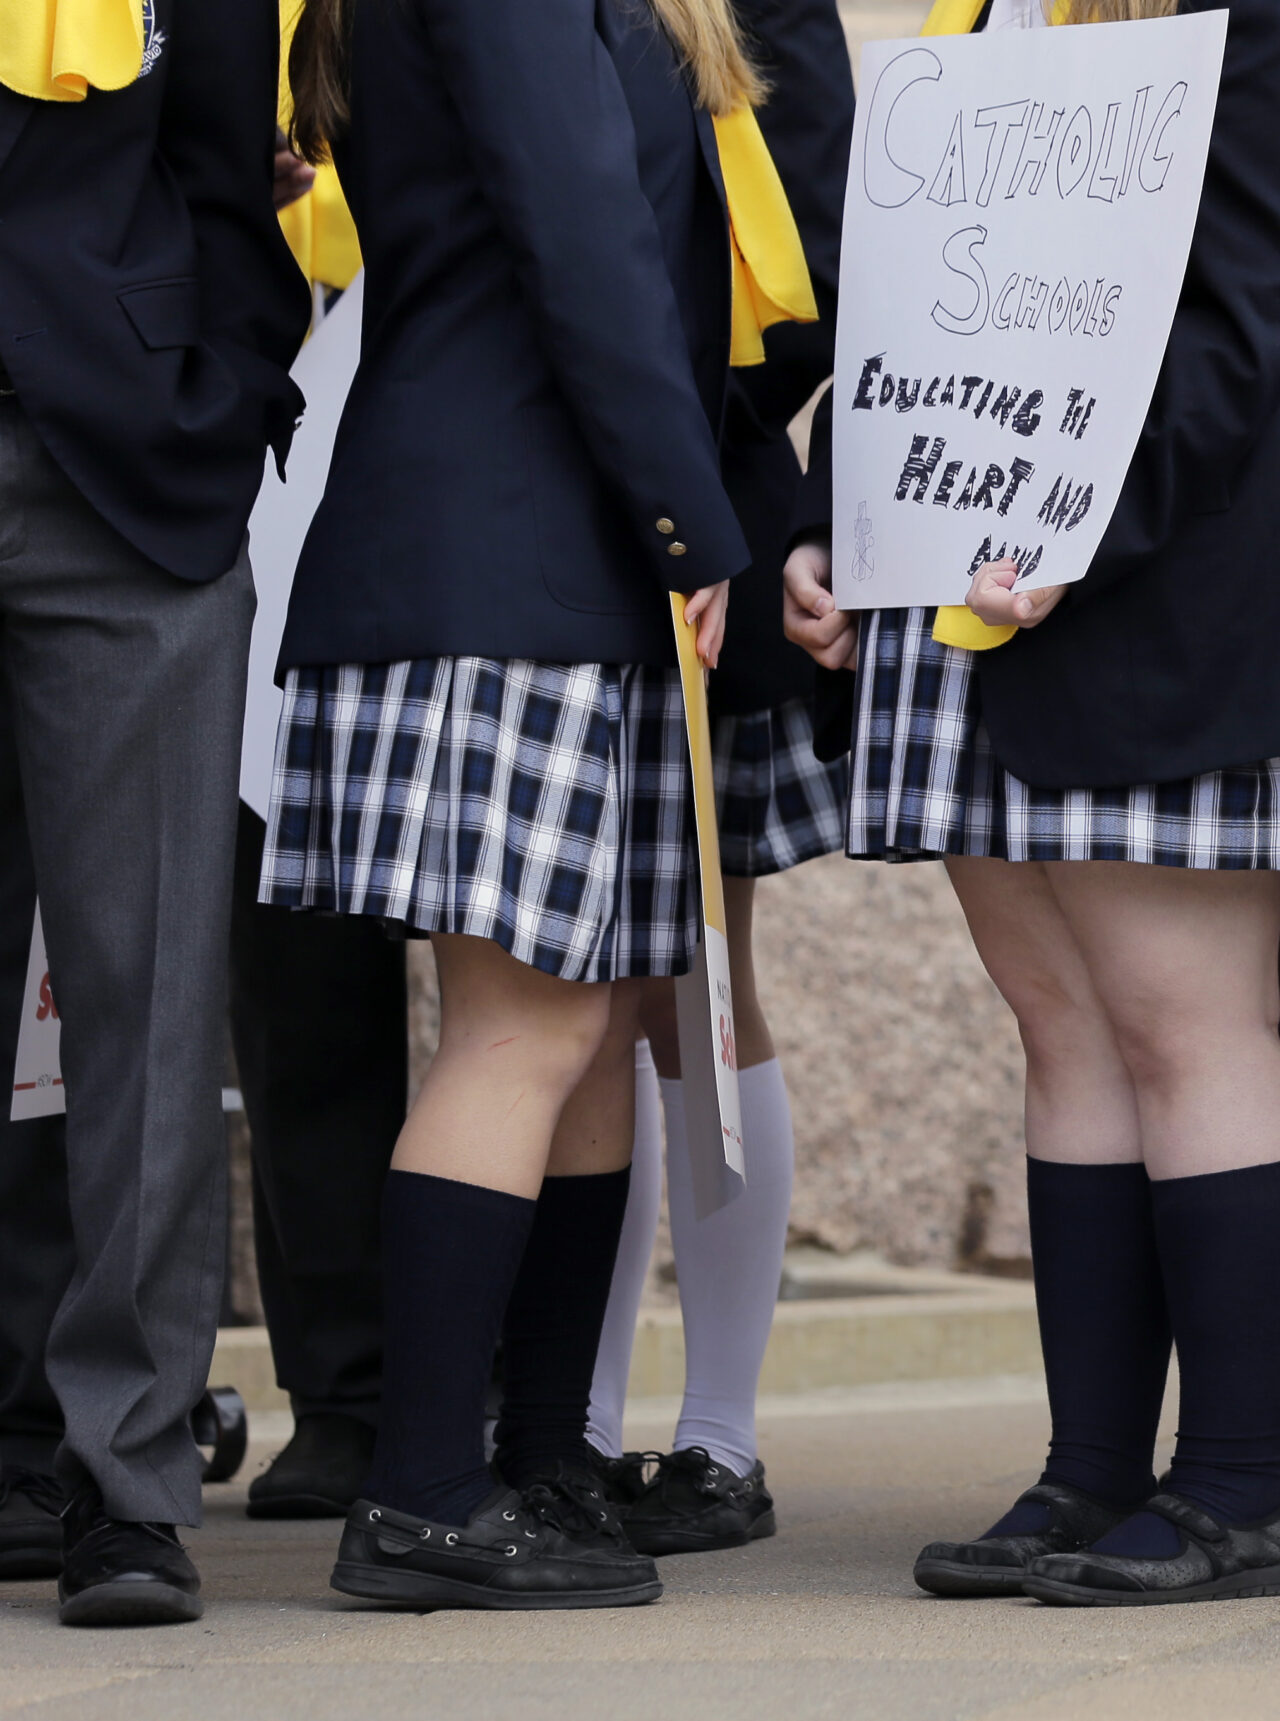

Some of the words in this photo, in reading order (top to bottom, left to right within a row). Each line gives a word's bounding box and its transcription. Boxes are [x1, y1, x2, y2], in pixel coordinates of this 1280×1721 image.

[864, 48, 1187, 208] CATHOLIC
[931, 224, 1121, 337] SCHOOLS
[852, 351, 1043, 436] EDUCATING
[894, 433, 1035, 517] HEART
[1037, 472, 1093, 537] AND
